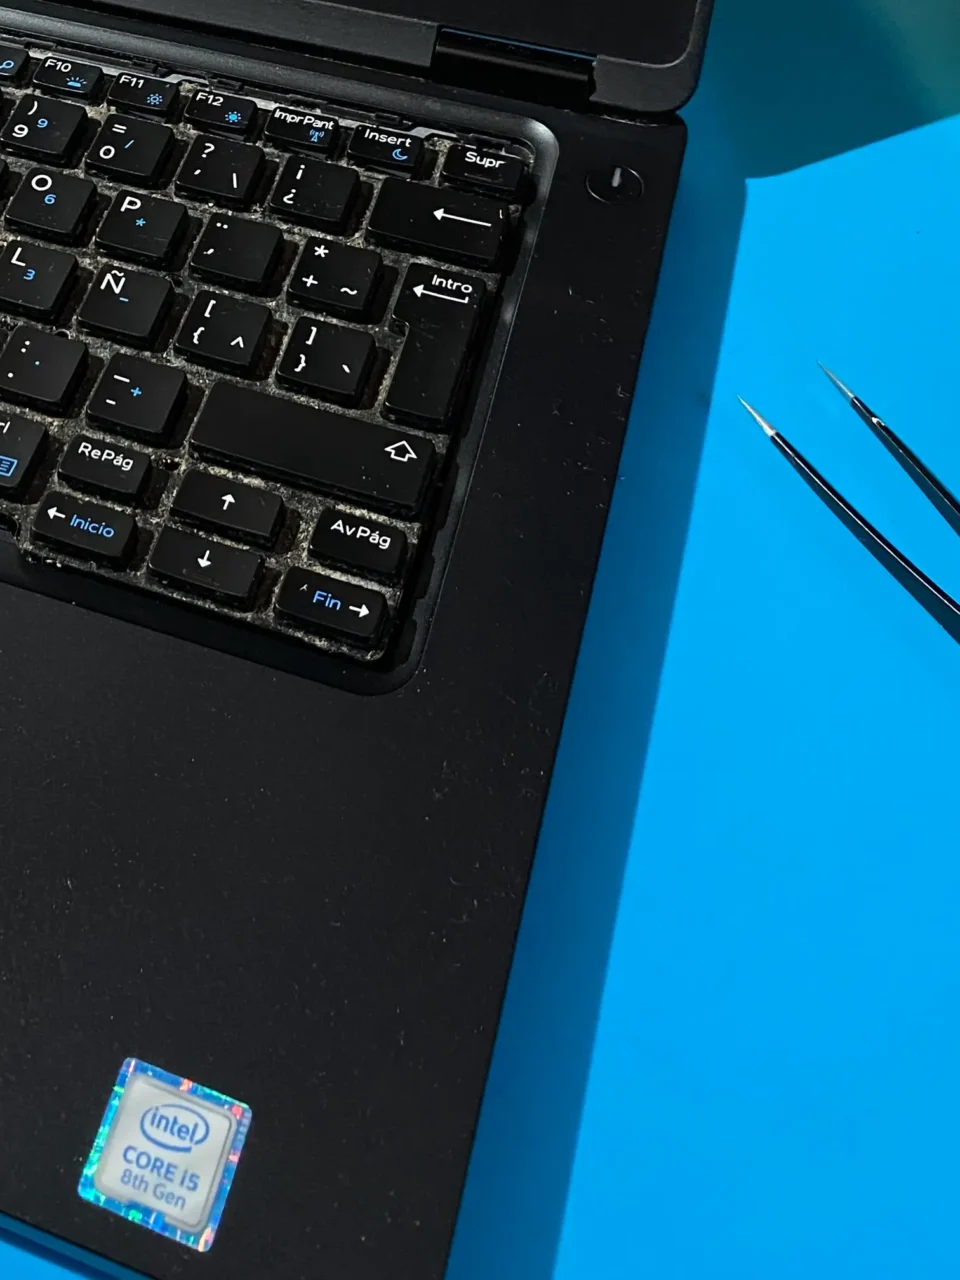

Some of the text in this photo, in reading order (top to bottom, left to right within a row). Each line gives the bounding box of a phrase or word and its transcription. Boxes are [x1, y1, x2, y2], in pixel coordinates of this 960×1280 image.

[44, 58, 72, 73] F10
[118, 74, 145, 90] F11
[27, 100, 38, 116] )
[195, 91, 225, 107] F12
[12, 124, 29, 138] 9
[36, 118, 49, 128] 9
[111, 123, 127, 134] =
[363, 128, 413, 149] Insert
[201, 142, 215, 158] ?
[464, 150, 507, 169] Supr
[31, 174, 53, 192] O
[44, 193, 57, 205] 6
[120, 195, 142, 212] P
[282, 188, 297, 205] ¿
[10, 246, 26, 267] L
[23, 268, 36, 281] 3
[99, 269, 126, 295] Ñ
[301, 274, 319, 288] +
[431, 274, 474, 294] Intro
[204, 299, 217, 318] [
[192, 326, 205, 345] {
[305, 326, 317, 346] ]
[293, 353, 307, 373] }
[130, 386, 142, 397] +
[77, 440, 134, 471] RePág
[69, 514, 115, 538] Inicio
[330, 519, 391, 550] AvPág
[312, 590, 342, 611] Fin
[149, 1106, 200, 1143] intel
[123, 1145, 179, 1181] CORE
[121, 1168, 187, 1210] 8th Gen
